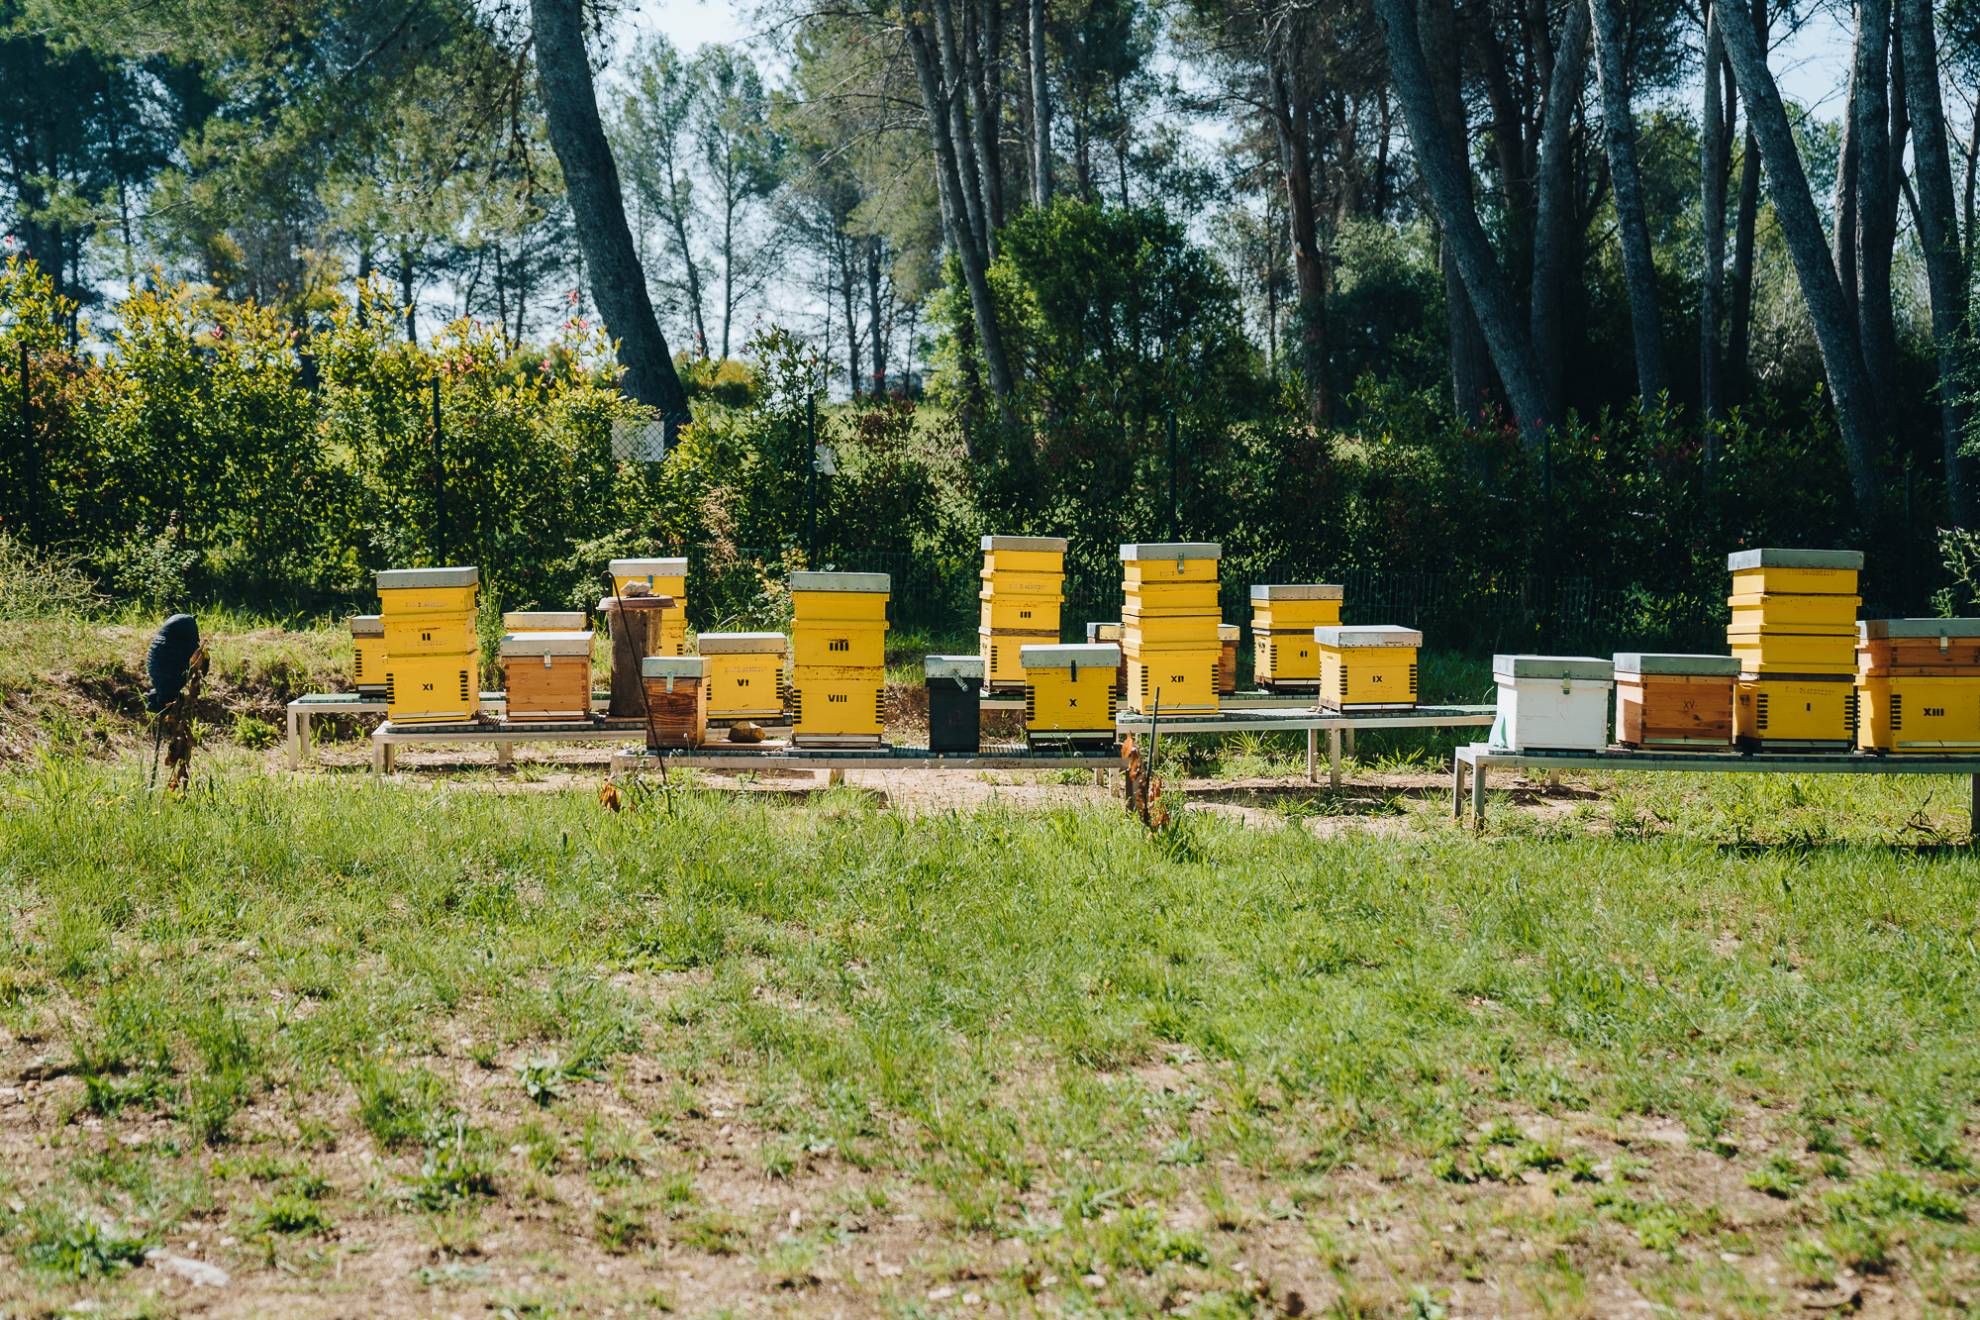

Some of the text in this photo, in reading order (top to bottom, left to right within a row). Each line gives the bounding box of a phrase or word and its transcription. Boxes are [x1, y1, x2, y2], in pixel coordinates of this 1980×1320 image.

[422, 633, 431, 641] II
[829, 642, 849, 652] IIII
[1300, 650, 1308, 658] II
[737, 679, 749, 687] VI
[1171, 675, 1184, 683] XII
[1372, 675, 1382, 683] IX
[423, 683, 434, 691] XI
[828, 694, 848, 703] VIII
[1069, 698, 1077, 707] X
[1923, 708, 1944, 717] XIII
